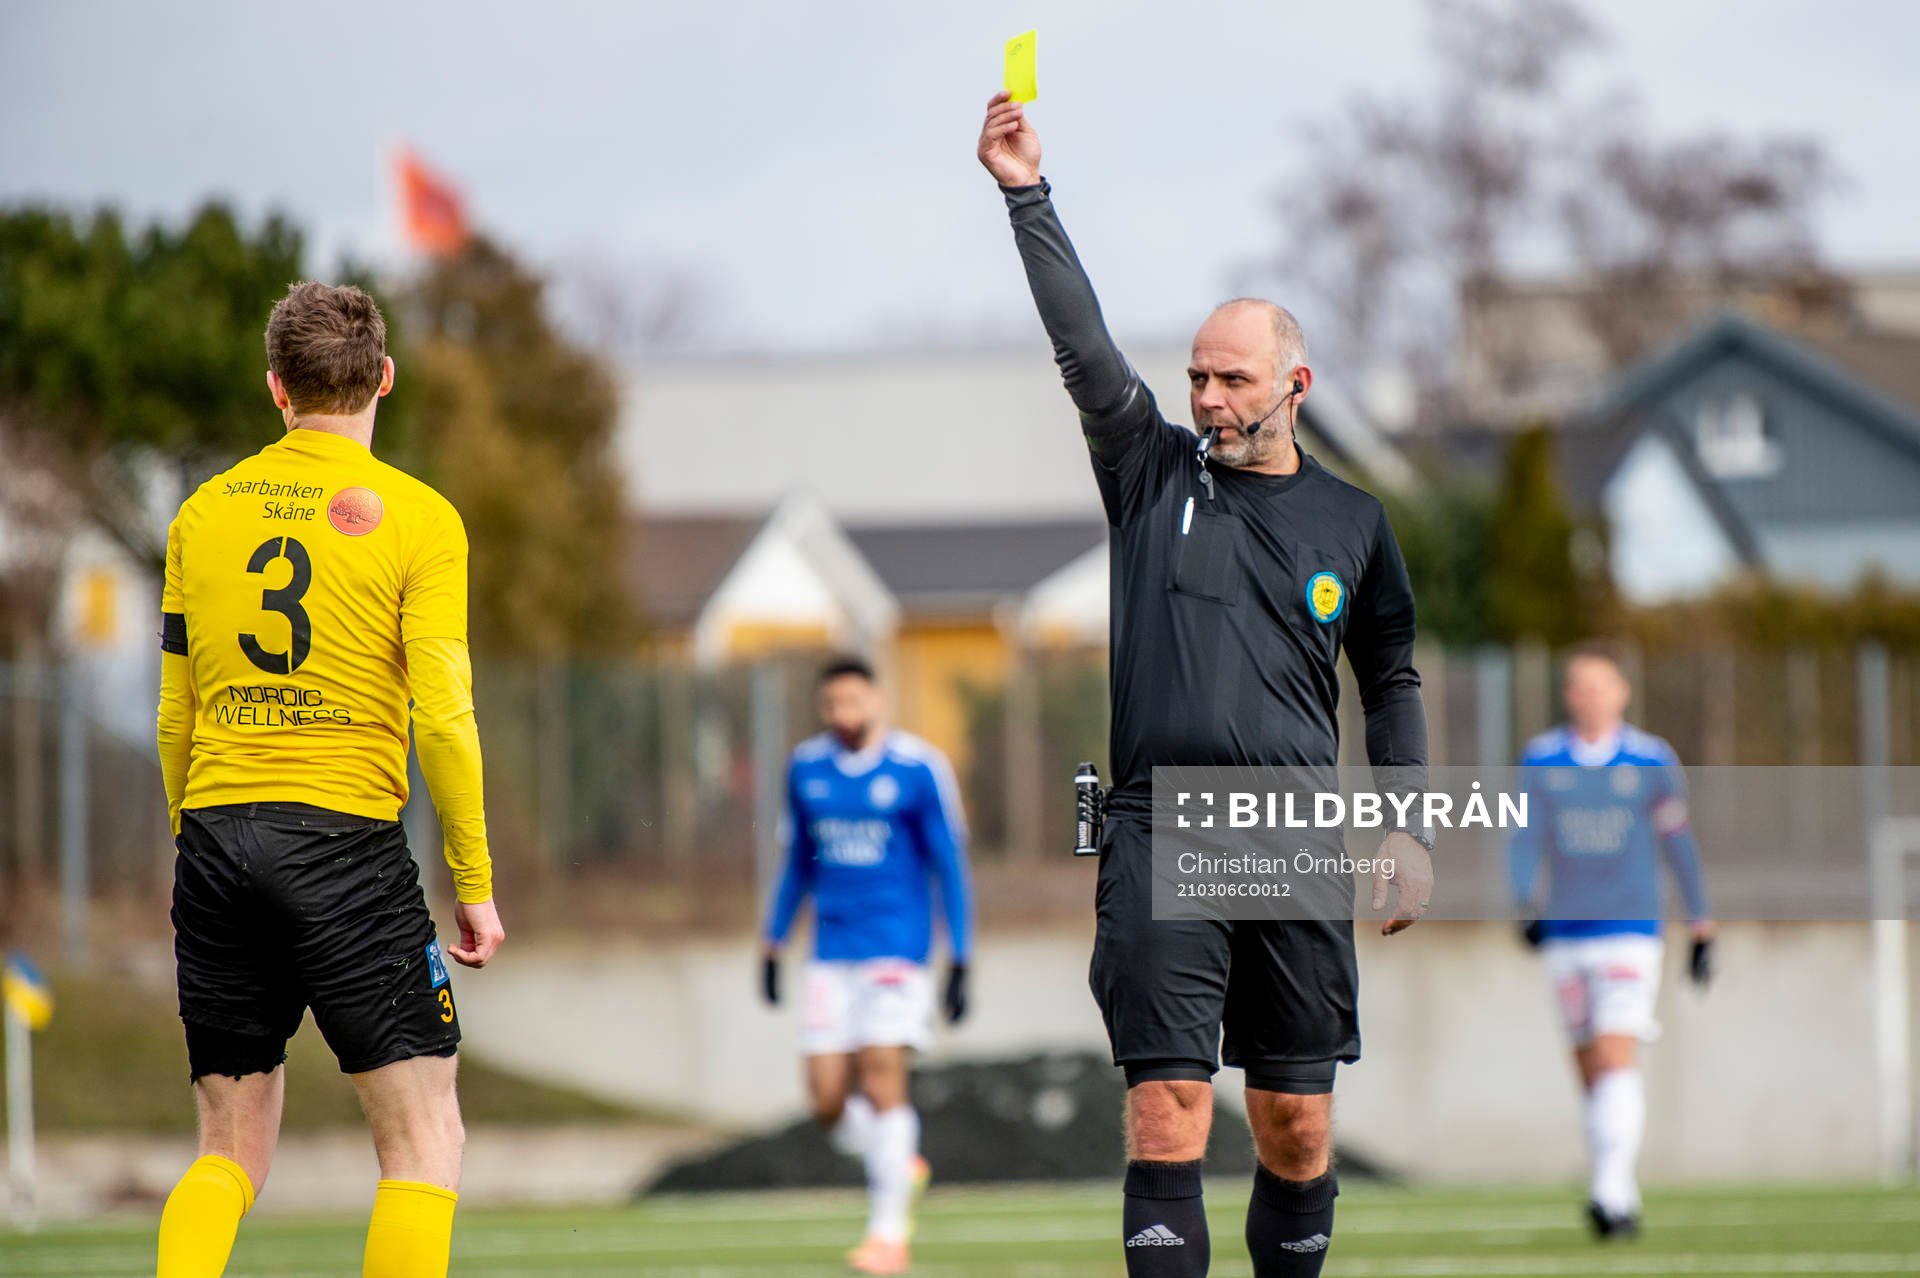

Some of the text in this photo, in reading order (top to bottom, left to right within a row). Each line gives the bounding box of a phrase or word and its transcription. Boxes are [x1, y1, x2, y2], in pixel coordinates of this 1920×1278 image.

[262, 501, 316, 521] Skåne
[238, 536, 312, 675] 3
[228, 686, 323, 707] NORDIC
[214, 704, 351, 727] WELLNESS
[438, 988, 454, 1023] 3
[1126, 1237, 1185, 1248] adidas
